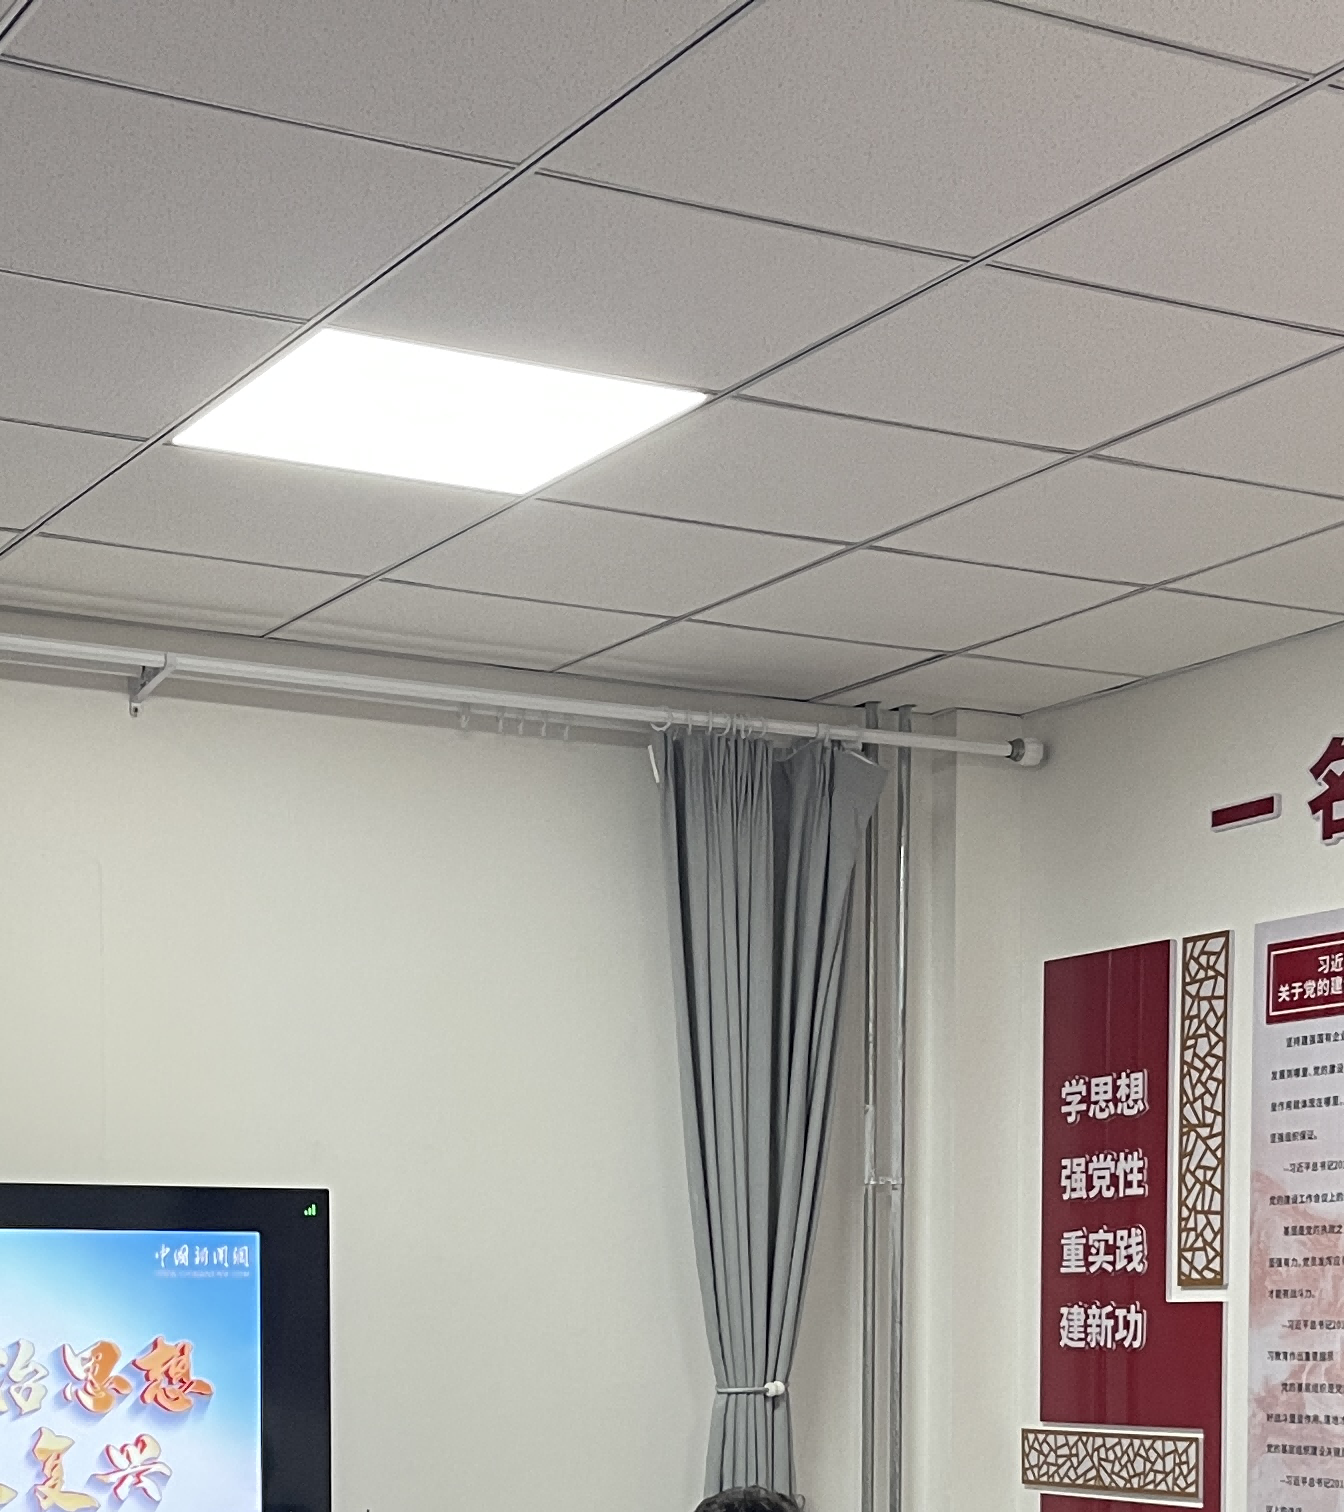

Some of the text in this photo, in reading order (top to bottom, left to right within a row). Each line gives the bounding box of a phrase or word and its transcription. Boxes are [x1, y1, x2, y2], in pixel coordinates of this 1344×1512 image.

[1061, 1071, 1145, 1124] 学思想
[1061, 1150, 1145, 1200] 强党性
[1060, 1226, 1145, 1275] 重实践
[1059, 1302, 1142, 1349] 建新功
